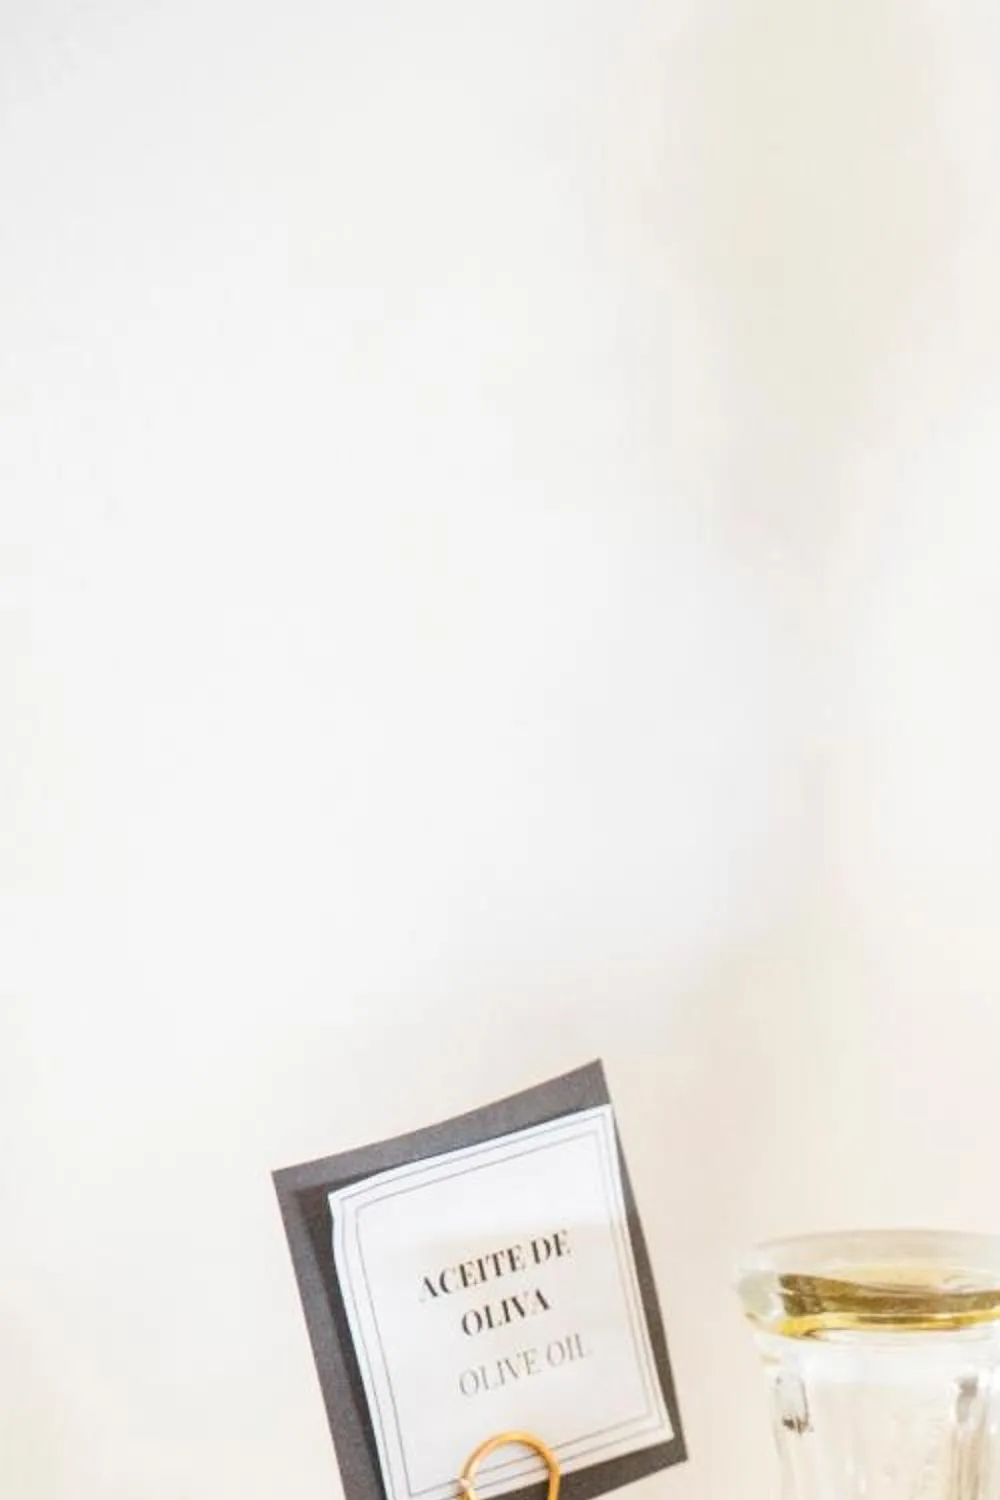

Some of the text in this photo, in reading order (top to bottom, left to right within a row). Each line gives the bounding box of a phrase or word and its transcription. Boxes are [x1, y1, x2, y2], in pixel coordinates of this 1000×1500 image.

[419, 1229, 572, 1302] ACEITE DE
[461, 1289, 551, 1337] OLIVA
[459, 1333, 592, 1397] OLIVE OIL
